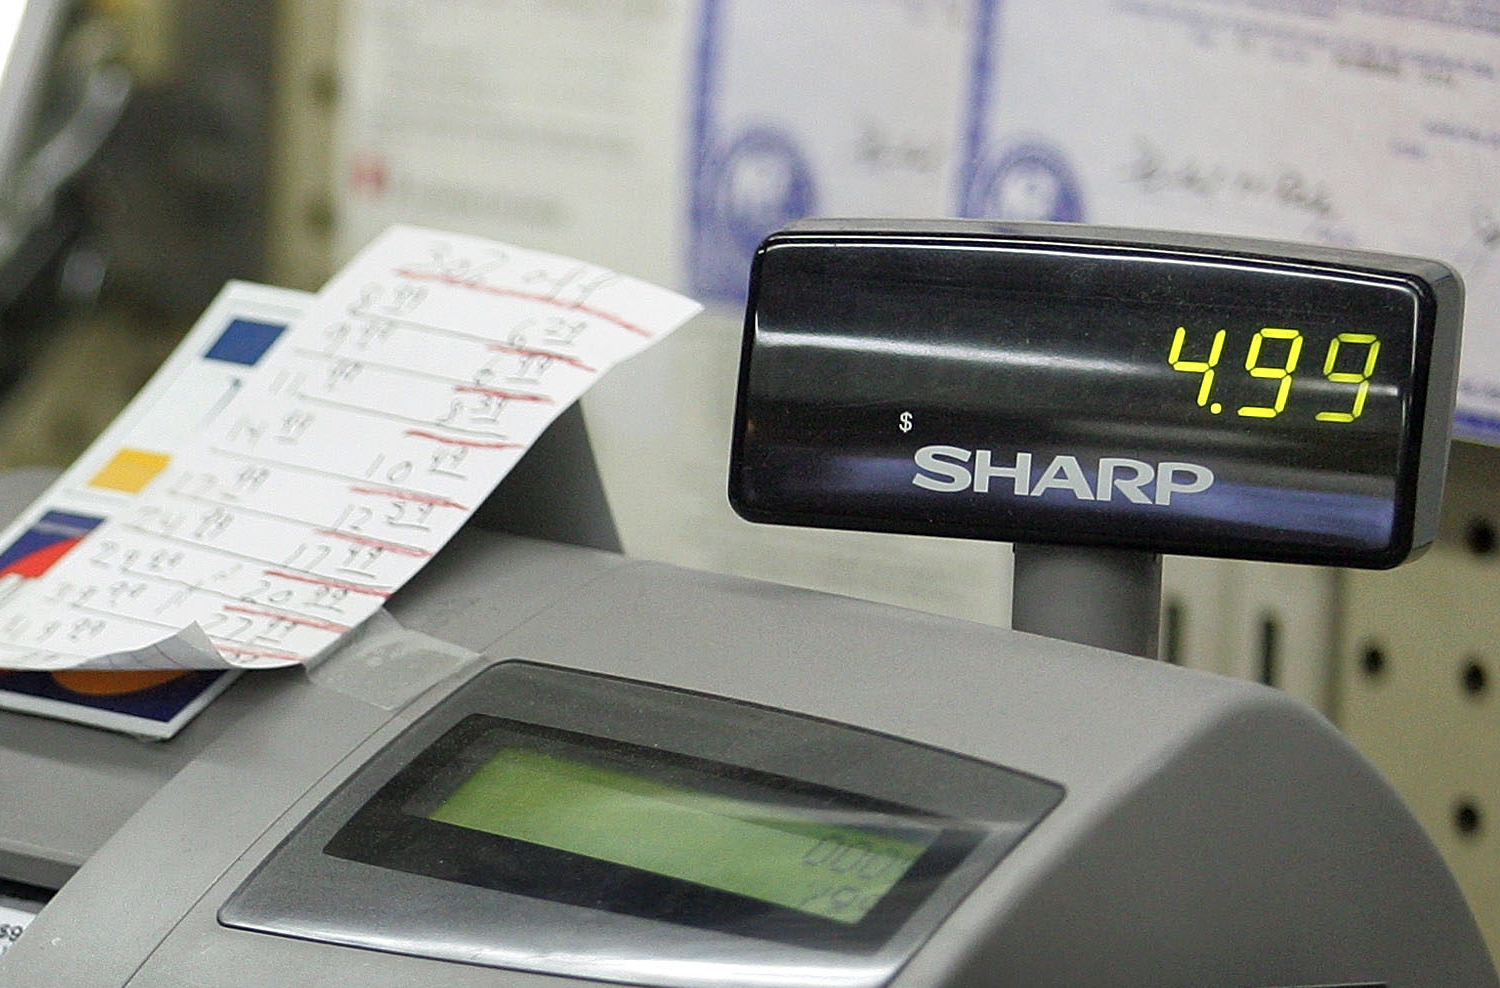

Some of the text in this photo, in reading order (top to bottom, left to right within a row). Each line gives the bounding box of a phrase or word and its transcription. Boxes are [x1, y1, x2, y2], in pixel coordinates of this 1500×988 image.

[1168, 325, 1381, 423] 4.99
[898, 411, 914, 435] $
[912, 445, 1215, 507] SHARP
